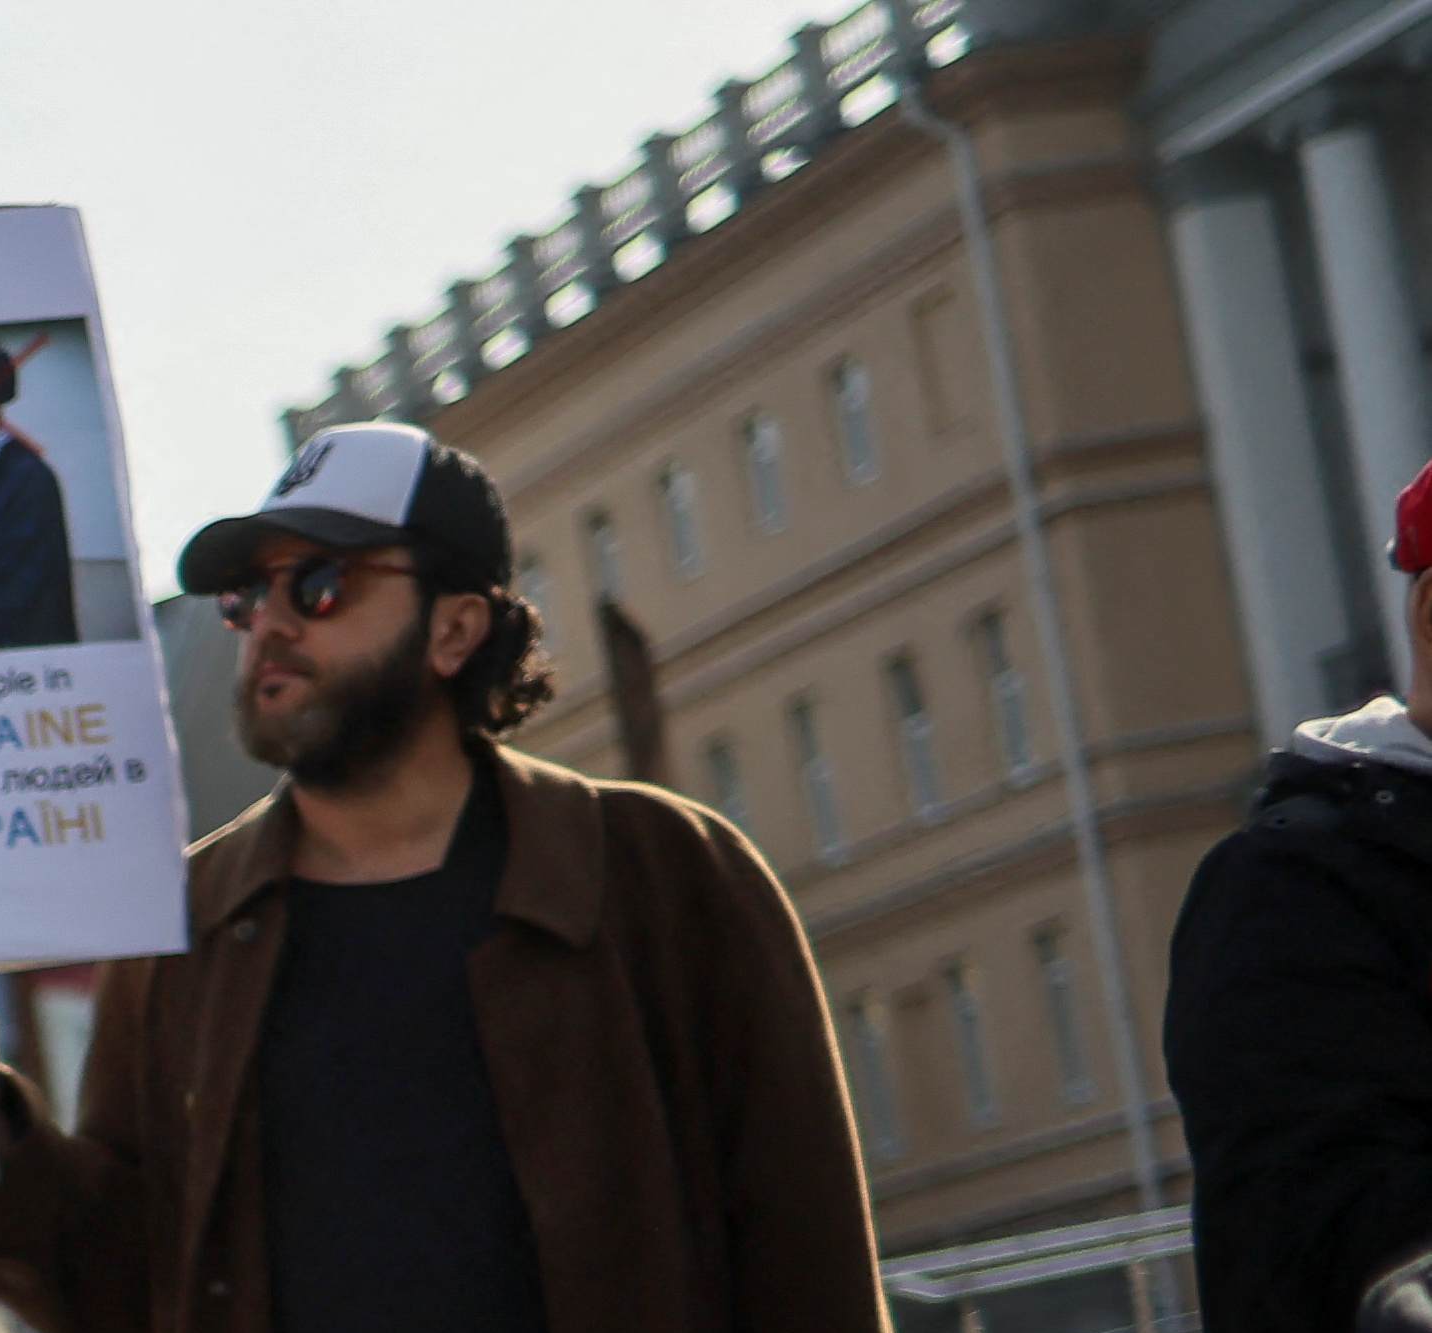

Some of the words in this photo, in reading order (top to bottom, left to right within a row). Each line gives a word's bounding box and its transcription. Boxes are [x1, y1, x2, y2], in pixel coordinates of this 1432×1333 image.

[45, 667, 72, 690] in
[2, 755, 115, 795] людей
[125, 758, 147, 782] в
